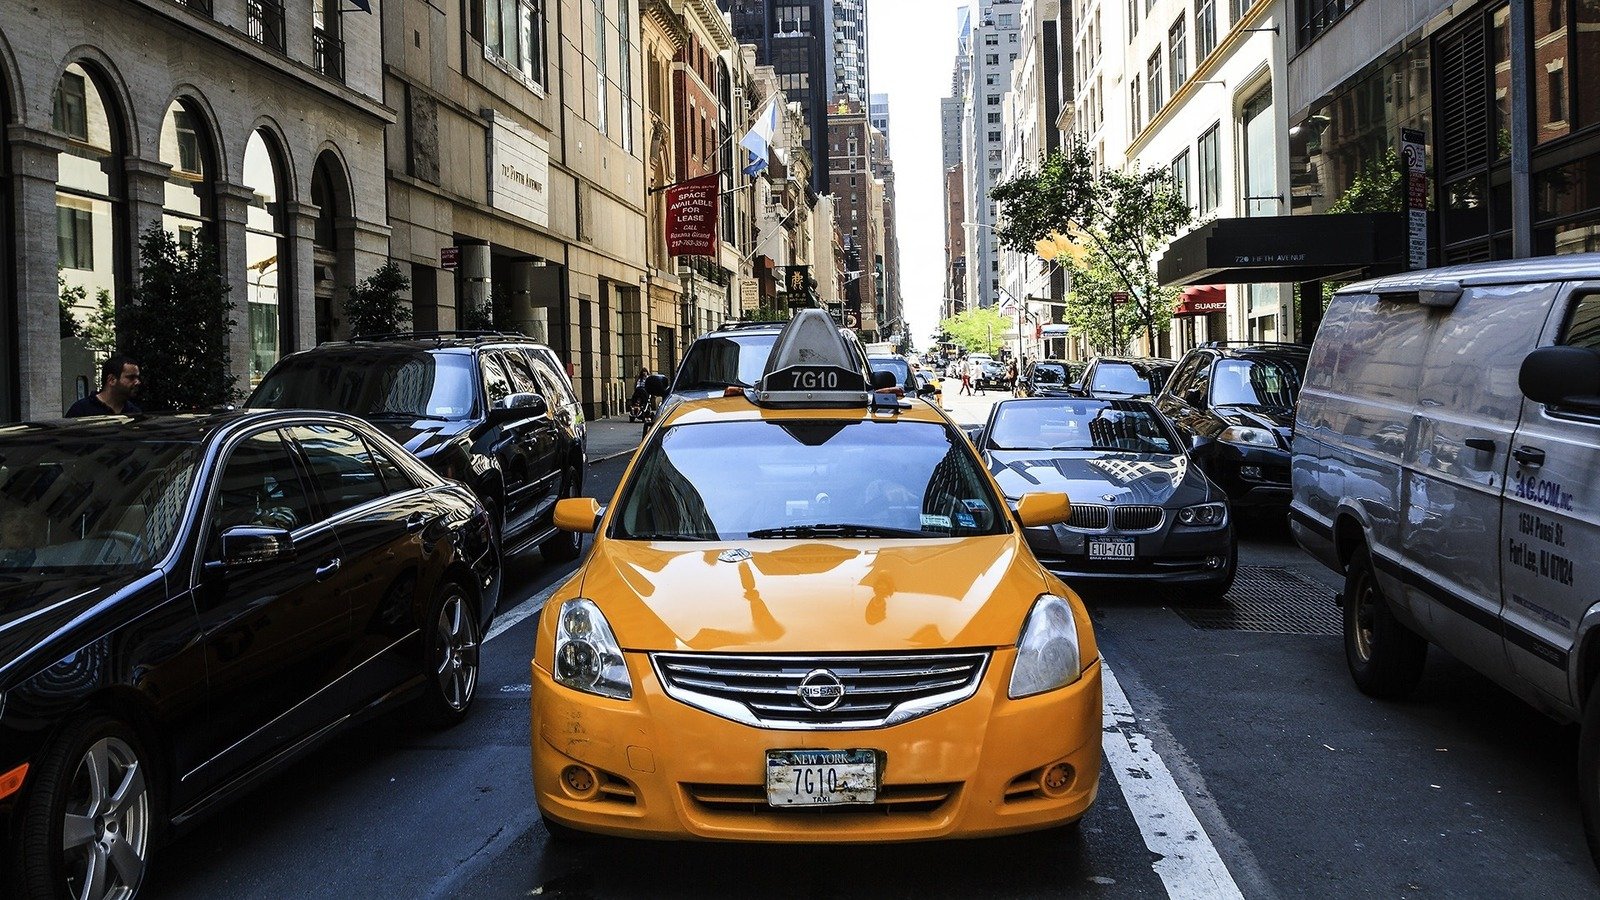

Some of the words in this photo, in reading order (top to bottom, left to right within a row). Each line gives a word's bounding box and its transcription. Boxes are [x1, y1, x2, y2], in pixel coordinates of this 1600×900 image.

[525, 173, 543, 194] AVENUE
[678, 191, 706, 201] SPACE
[670, 199, 714, 211] AVAILABLE
[682, 206, 700, 214] FOR
[677, 214, 705, 222] LEASE
[1194, 302, 1228, 310] SUAREZ
[791, 371, 838, 388] 7G10
[1509, 537, 1522, 567] Fort
[802, 686, 841, 696] NISSAN
[794, 755, 818, 765] NEW
[820, 753, 849, 765] YORK
[793, 767, 838, 796] 7G10
